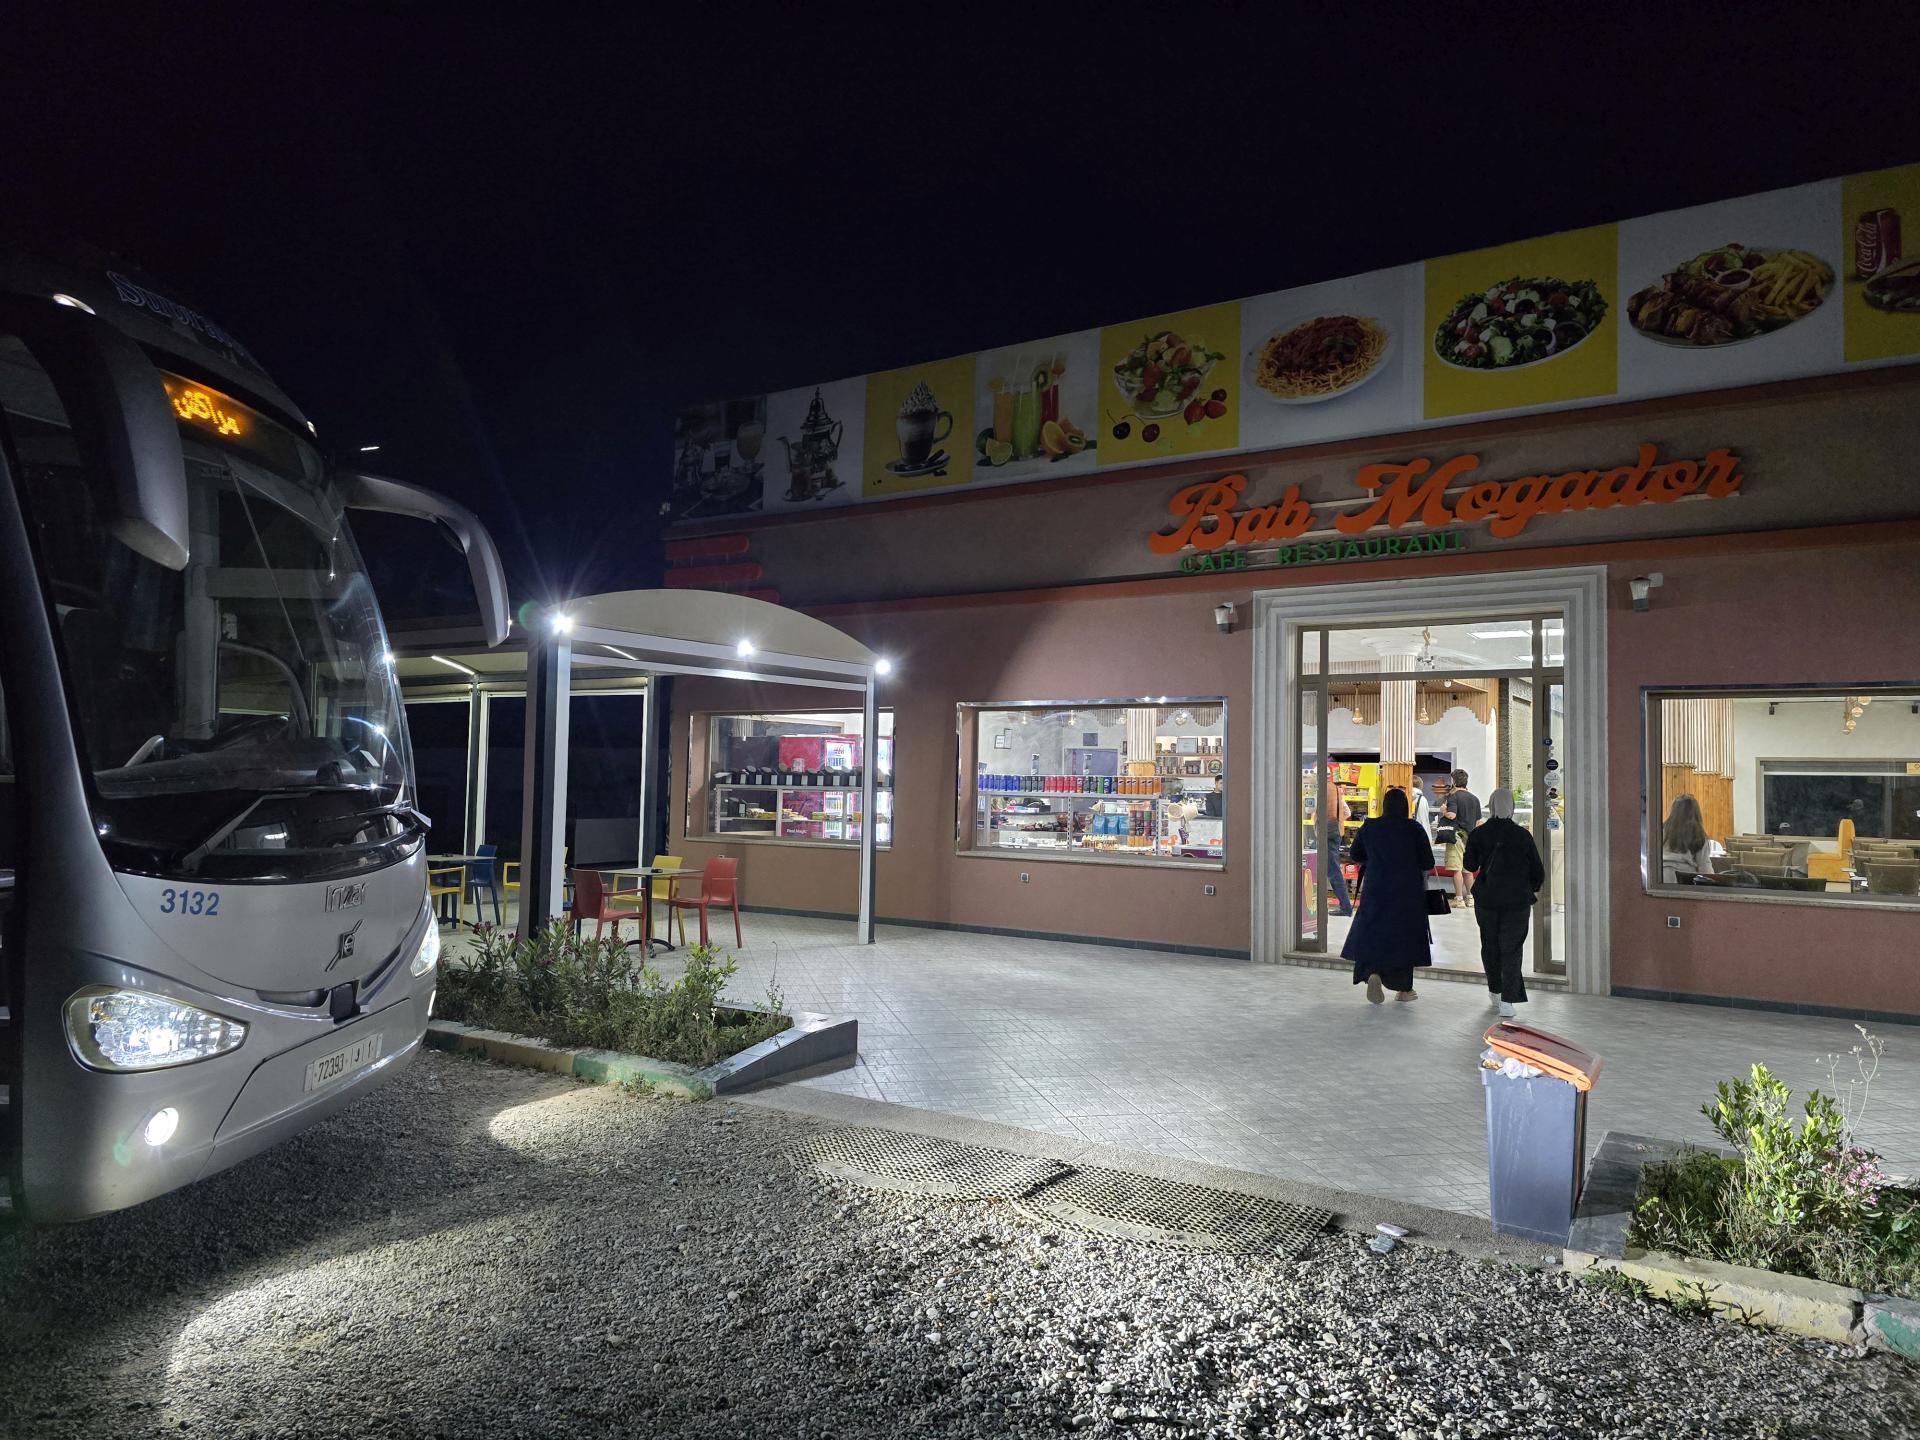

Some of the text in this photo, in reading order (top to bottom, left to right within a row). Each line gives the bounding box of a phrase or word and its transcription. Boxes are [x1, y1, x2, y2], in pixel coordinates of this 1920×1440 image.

[1148, 442, 1743, 555] Bab Mogador
[1276, 530, 1464, 566] RESTAURANT
[160, 888, 220, 916] 3132
[317, 1053, 345, 1082] 72393
